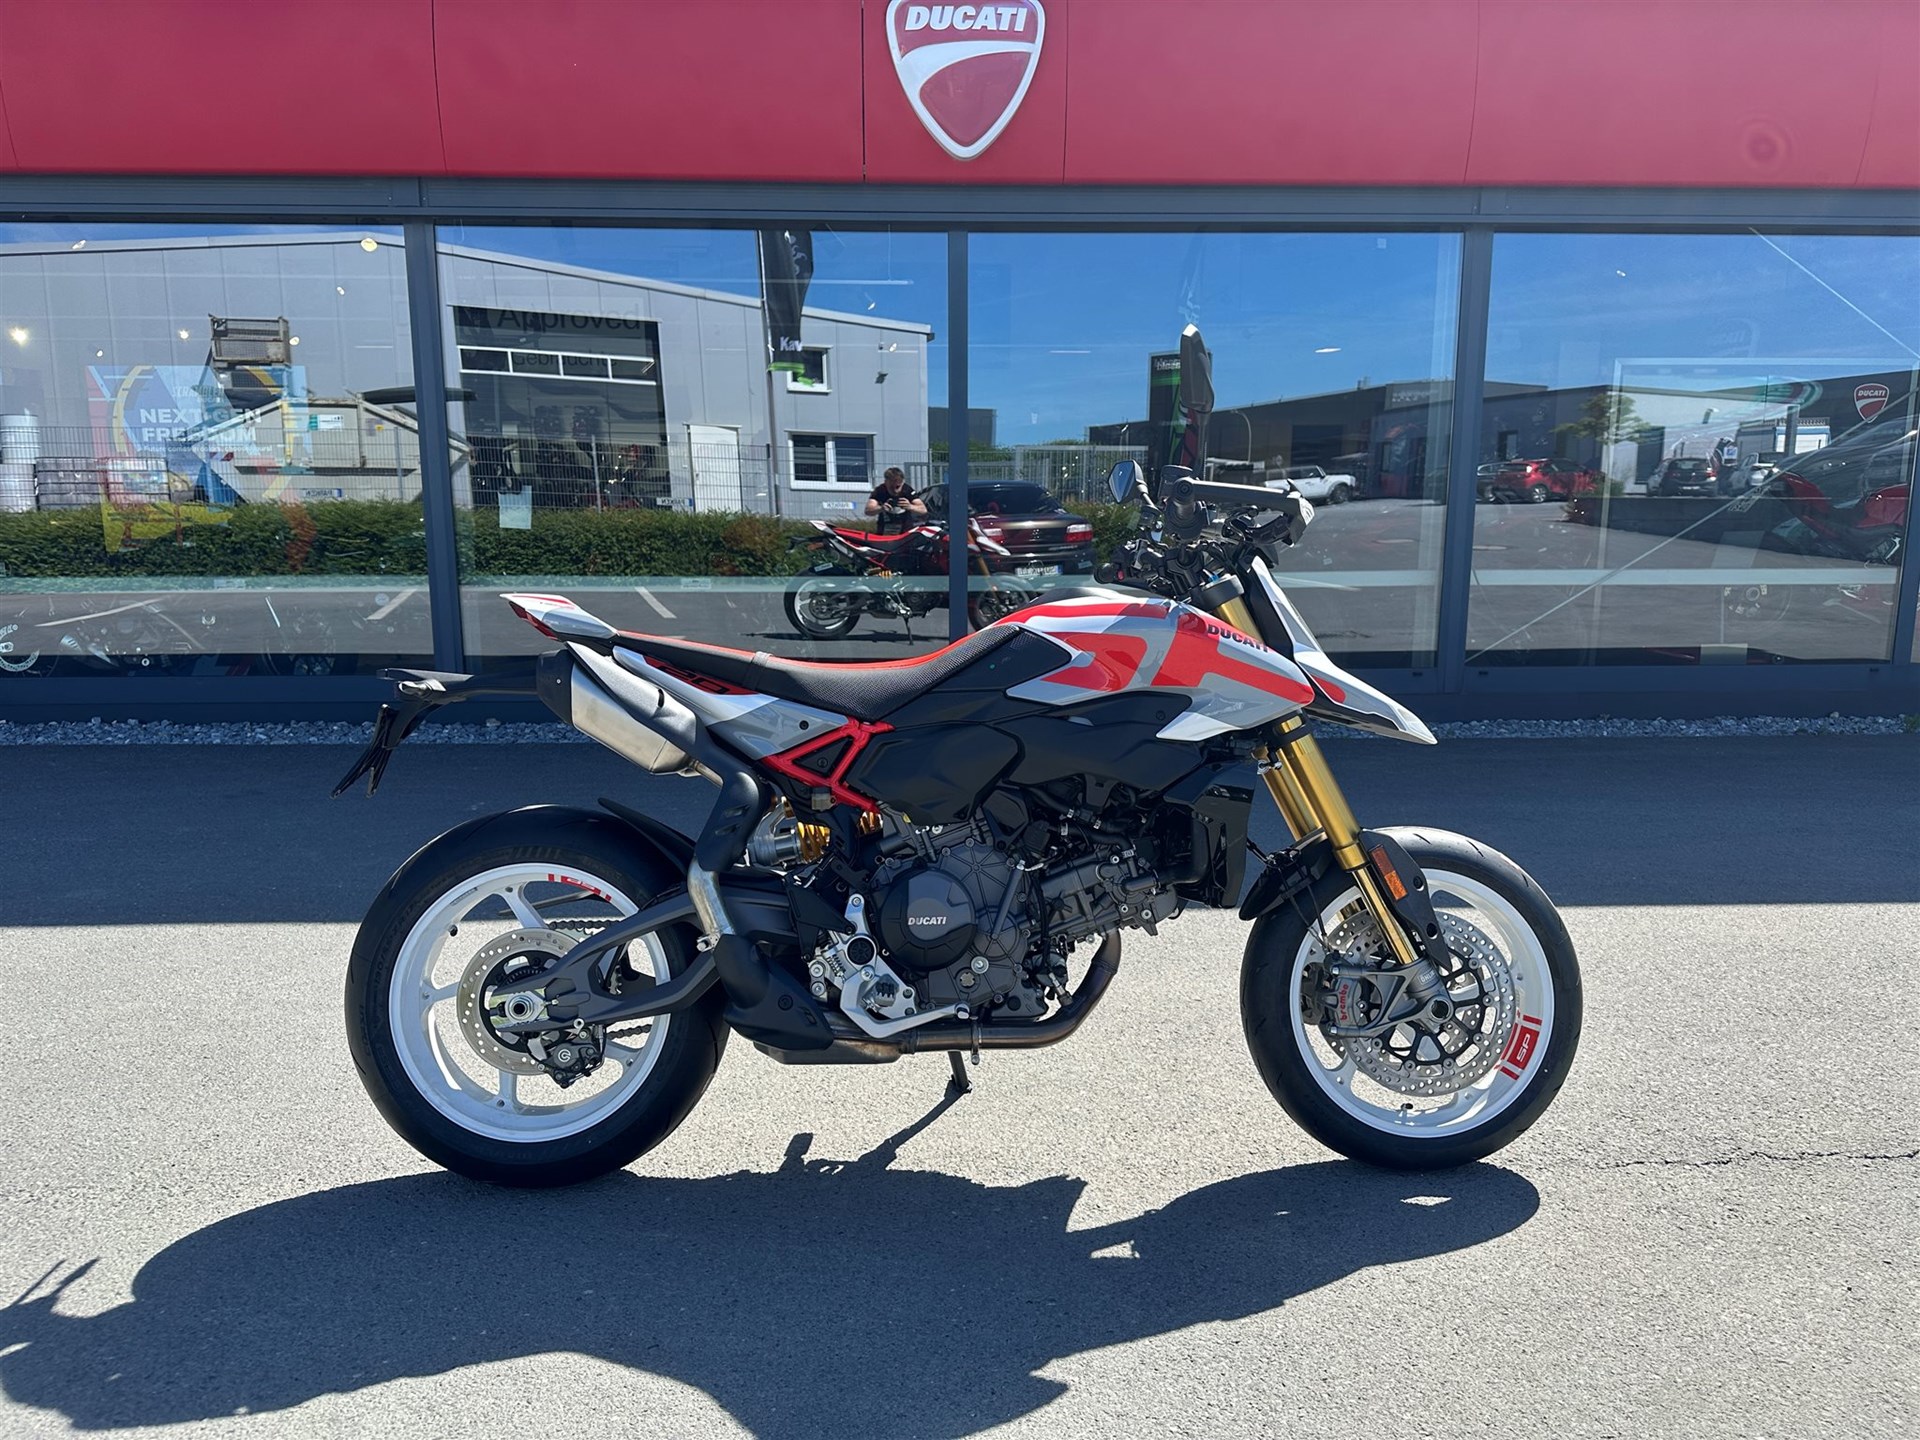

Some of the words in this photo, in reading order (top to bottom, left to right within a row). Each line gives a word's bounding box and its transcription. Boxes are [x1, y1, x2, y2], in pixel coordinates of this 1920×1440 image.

[905, 6, 1028, 32] DUCATI
[497, 303, 641, 333] Approved
[1857, 389, 1887, 398] DUCATI
[1207, 623, 1269, 654] DUCATI
[908, 916, 947, 926] DUCATI
[1340, 983, 1349, 1021] brembo
[1516, 1032, 1531, 1063] SP
